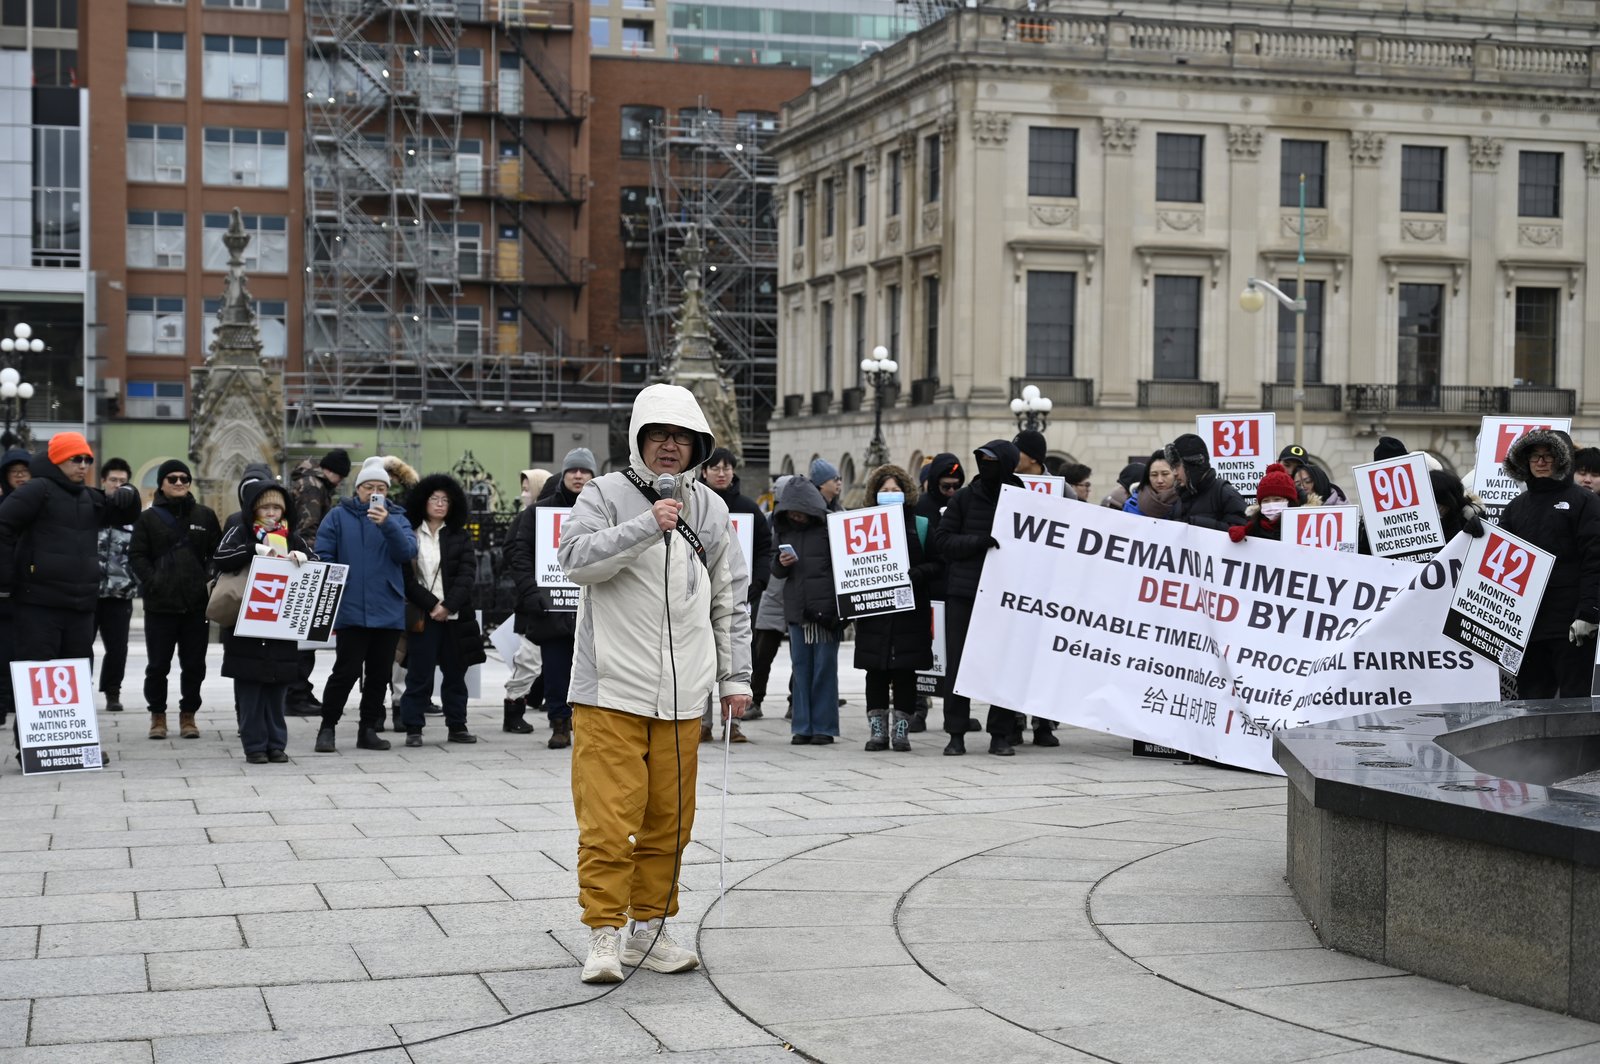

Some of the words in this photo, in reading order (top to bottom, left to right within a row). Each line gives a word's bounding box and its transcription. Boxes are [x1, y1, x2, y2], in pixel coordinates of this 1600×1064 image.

[1218, 420, 1255, 456] 31
[1218, 461, 1255, 470] MONTHS
[1217, 472, 1245, 480] AITING
[1486, 479, 1519, 489] WAITIN
[1374, 465, 1413, 510] 90
[1479, 490, 1499, 500] IRCC
[1383, 511, 1419, 526] MONTHS
[1485, 507, 1497, 515] NO
[679, 525, 700, 548] SONY
[849, 513, 887, 554] 54
[1301, 513, 1338, 550] 40
[1377, 525, 1413, 540] WAITING
[1413, 521, 1431, 533] FOR
[1375, 541, 1395, 553] IRCC
[1395, 533, 1439, 550] RESPONSE
[852, 553, 888, 566] MONTHS
[1013, 512, 1070, 549] WE
[1077, 528, 1201, 578] DEMAND
[1204, 555, 1214, 584] A
[1221, 558, 1349, 606] TIMELY
[1486, 540, 1528, 593] 42
[844, 566, 880, 578] WAITING
[881, 562, 899, 572] FOR
[841, 579, 860, 589] IRCC
[860, 572, 905, 586] RESPONSE
[248, 579, 286, 614] 14
[282, 581, 299, 619] MONTHS
[289, 593, 305, 629] WAITING
[301, 573, 311, 592] FOR
[298, 615, 309, 635] IRCC
[304, 569, 321, 615] RESPONSE
[553, 598, 564, 606] NO
[850, 594, 861, 603] NO
[1478, 581, 1516, 608] MONTHS
[855, 603, 865, 611] NO
[1466, 588, 1503, 615] WAITING
[1503, 608, 1522, 626] FOR
[313, 617, 322, 628] NO
[322, 615, 330, 625] NO
[1248, 600, 1297, 634] BY
[1457, 597, 1478, 615] IRCC
[1477, 607, 1524, 641] RESPONSE
[1460, 618, 1471, 630] NO
[1000, 591, 1151, 640] REASONABLE
[1353, 650, 1474, 670] FAIRNESS
[1460, 630, 1471, 641] NO
[1052, 635, 1122, 667] Délais
[1126, 656, 1227, 690] raisonnables
[1233, 675, 1293, 707] Équité
[1293, 686, 1412, 711] procédurale
[35, 667, 73, 705] 18
[39, 709, 76, 719] MONTHS
[1141, 686, 1217, 727] 给出时限
[30, 720, 67, 731] WAITING
[70, 719, 87, 728] FOR
[26, 734, 46, 743] IRCC
[47, 730, 93, 741] RESPONSE
[37, 749, 48, 758] NO
[1145, 744, 1153, 752] NO
[41, 758, 52, 767] NO
[53, 756, 84, 766] RESULTS
